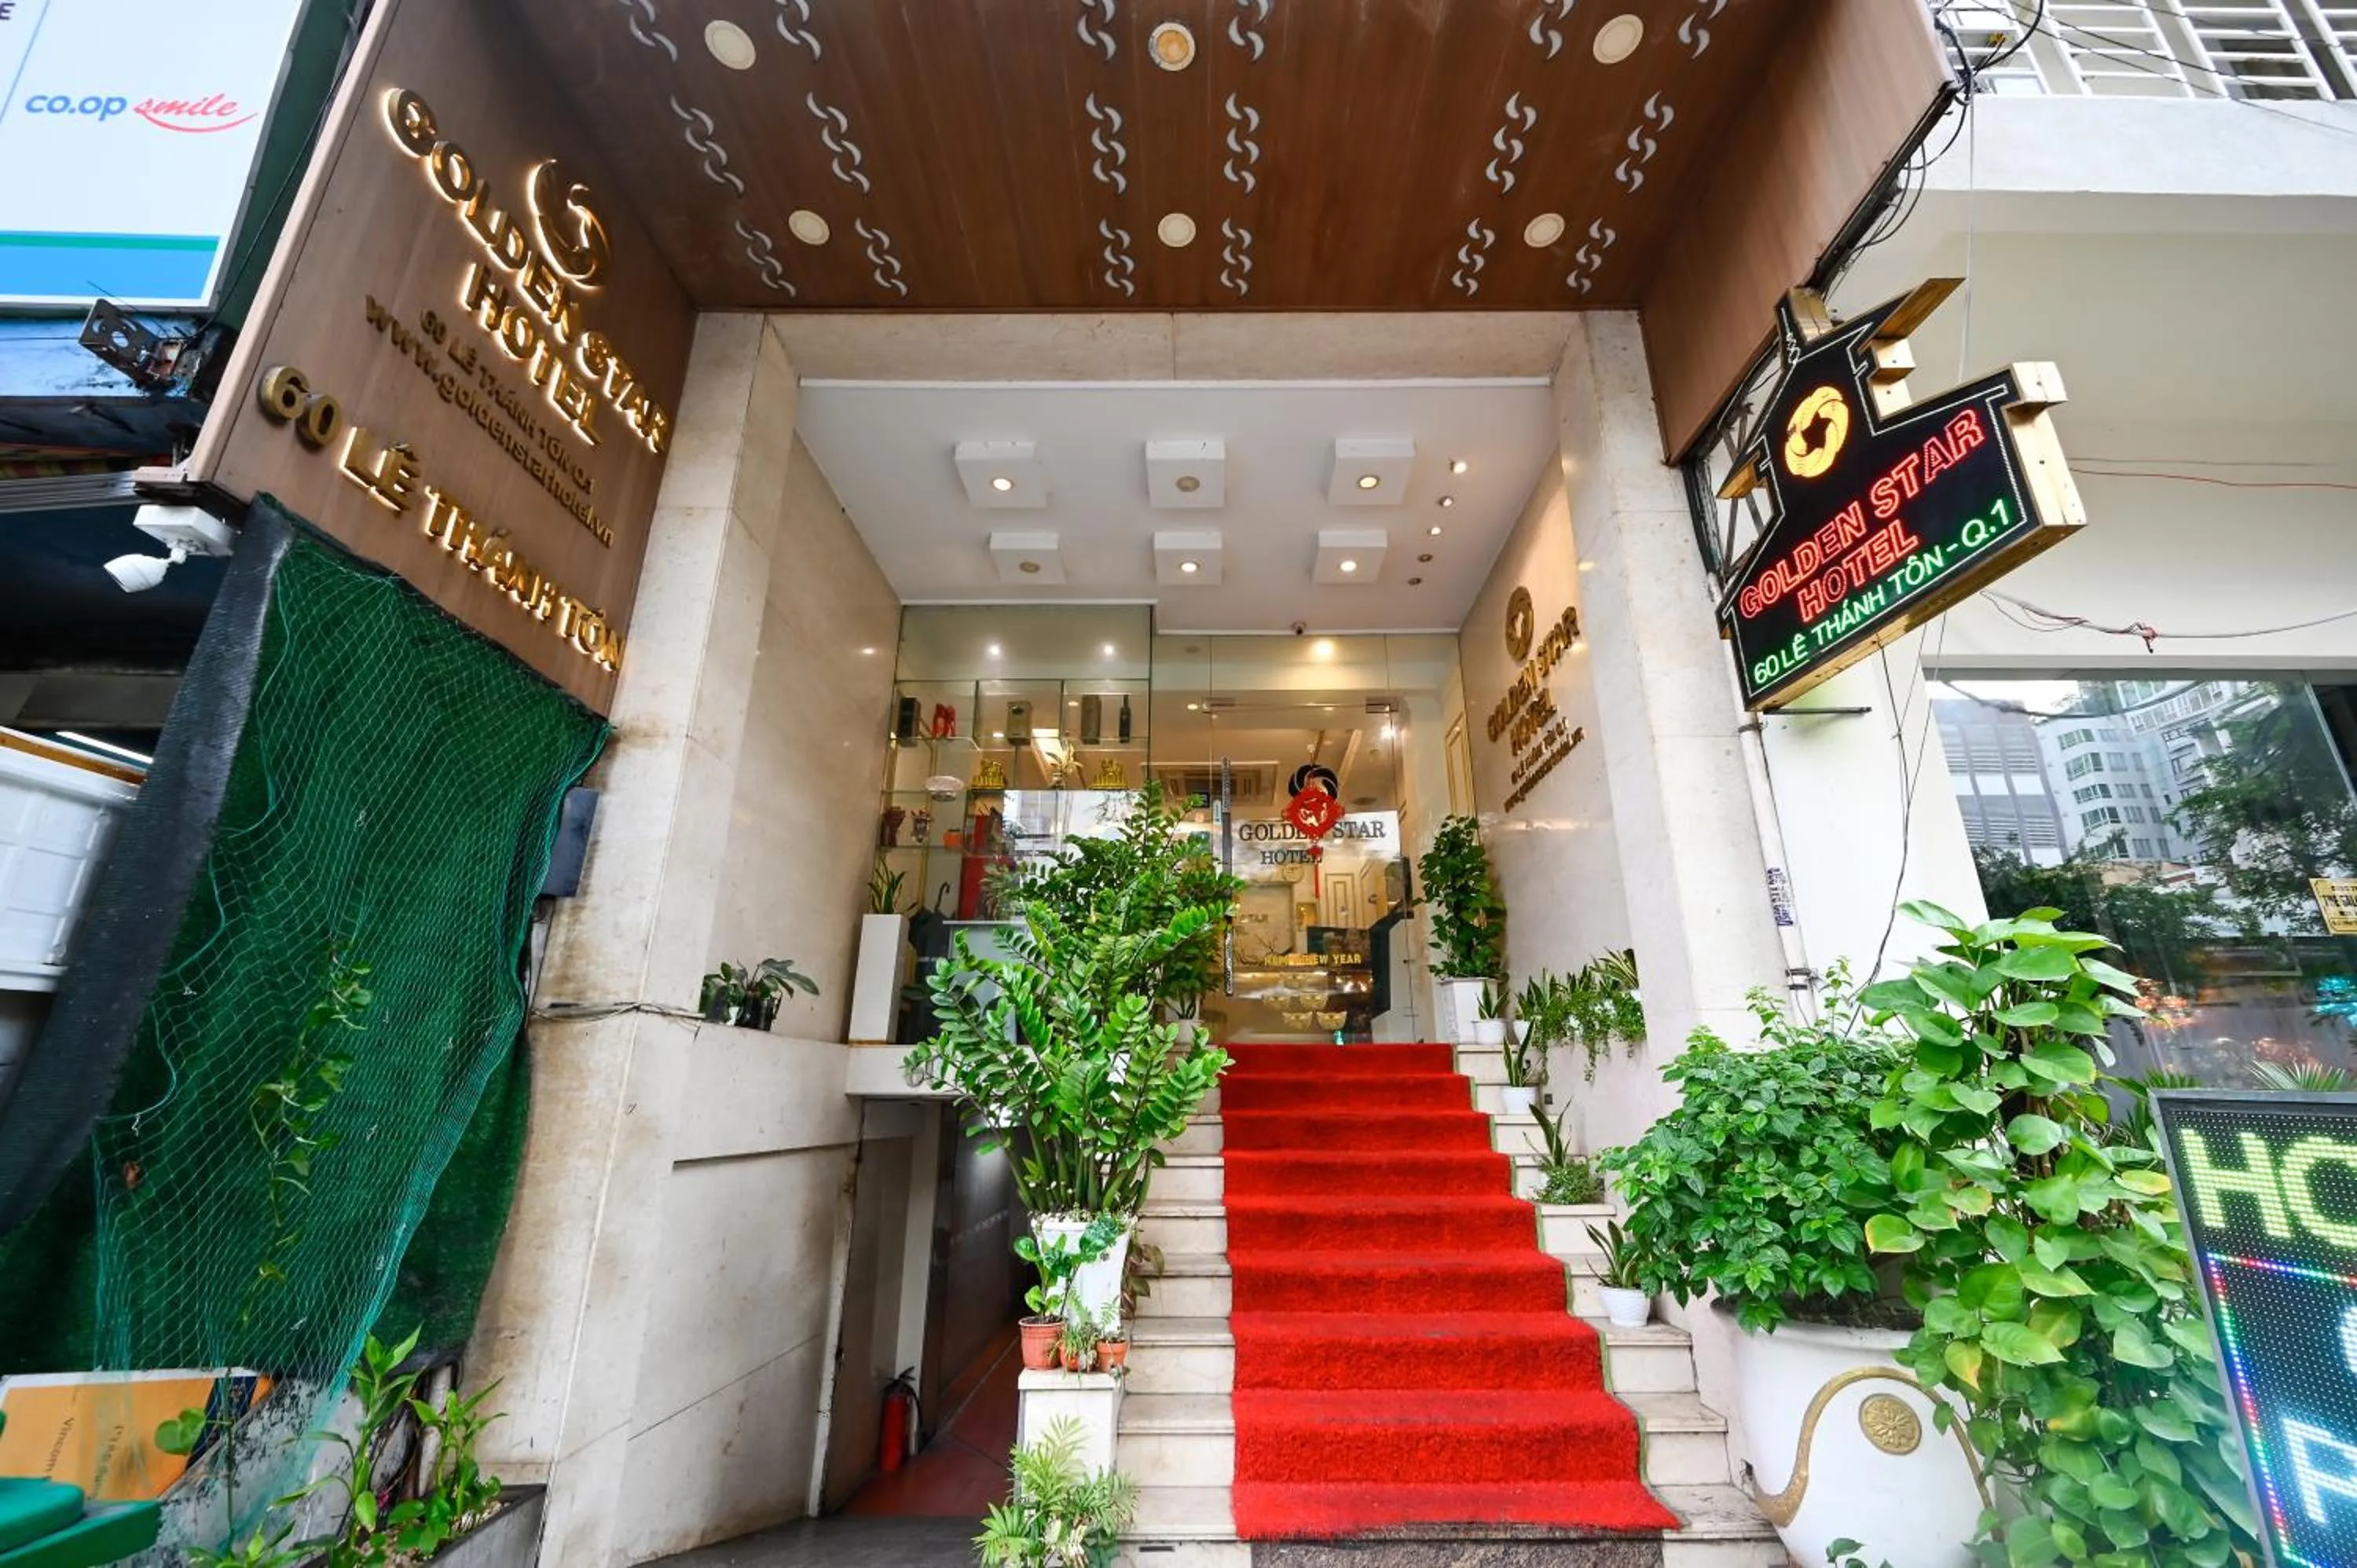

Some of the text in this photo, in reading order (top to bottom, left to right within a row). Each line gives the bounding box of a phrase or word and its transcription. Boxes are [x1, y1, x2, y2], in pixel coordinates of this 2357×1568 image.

[24, 93, 250, 126] co.op smile
[383, 88, 668, 452] GOLDEN STAR
[420, 310, 446, 345] 60
[459, 262, 605, 448] HOTEL
[258, 365, 626, 671] 60 LÊ THÁNH TÔN
[1739, 408, 1986, 619] GOLDEN STAR
[1797, 518, 1920, 624] HOTEL
[1811, 584, 1886, 645] THÁNH
[1239, 821, 1387, 841] GOLDE STAR
[1332, 953, 1362, 965] YEAR
